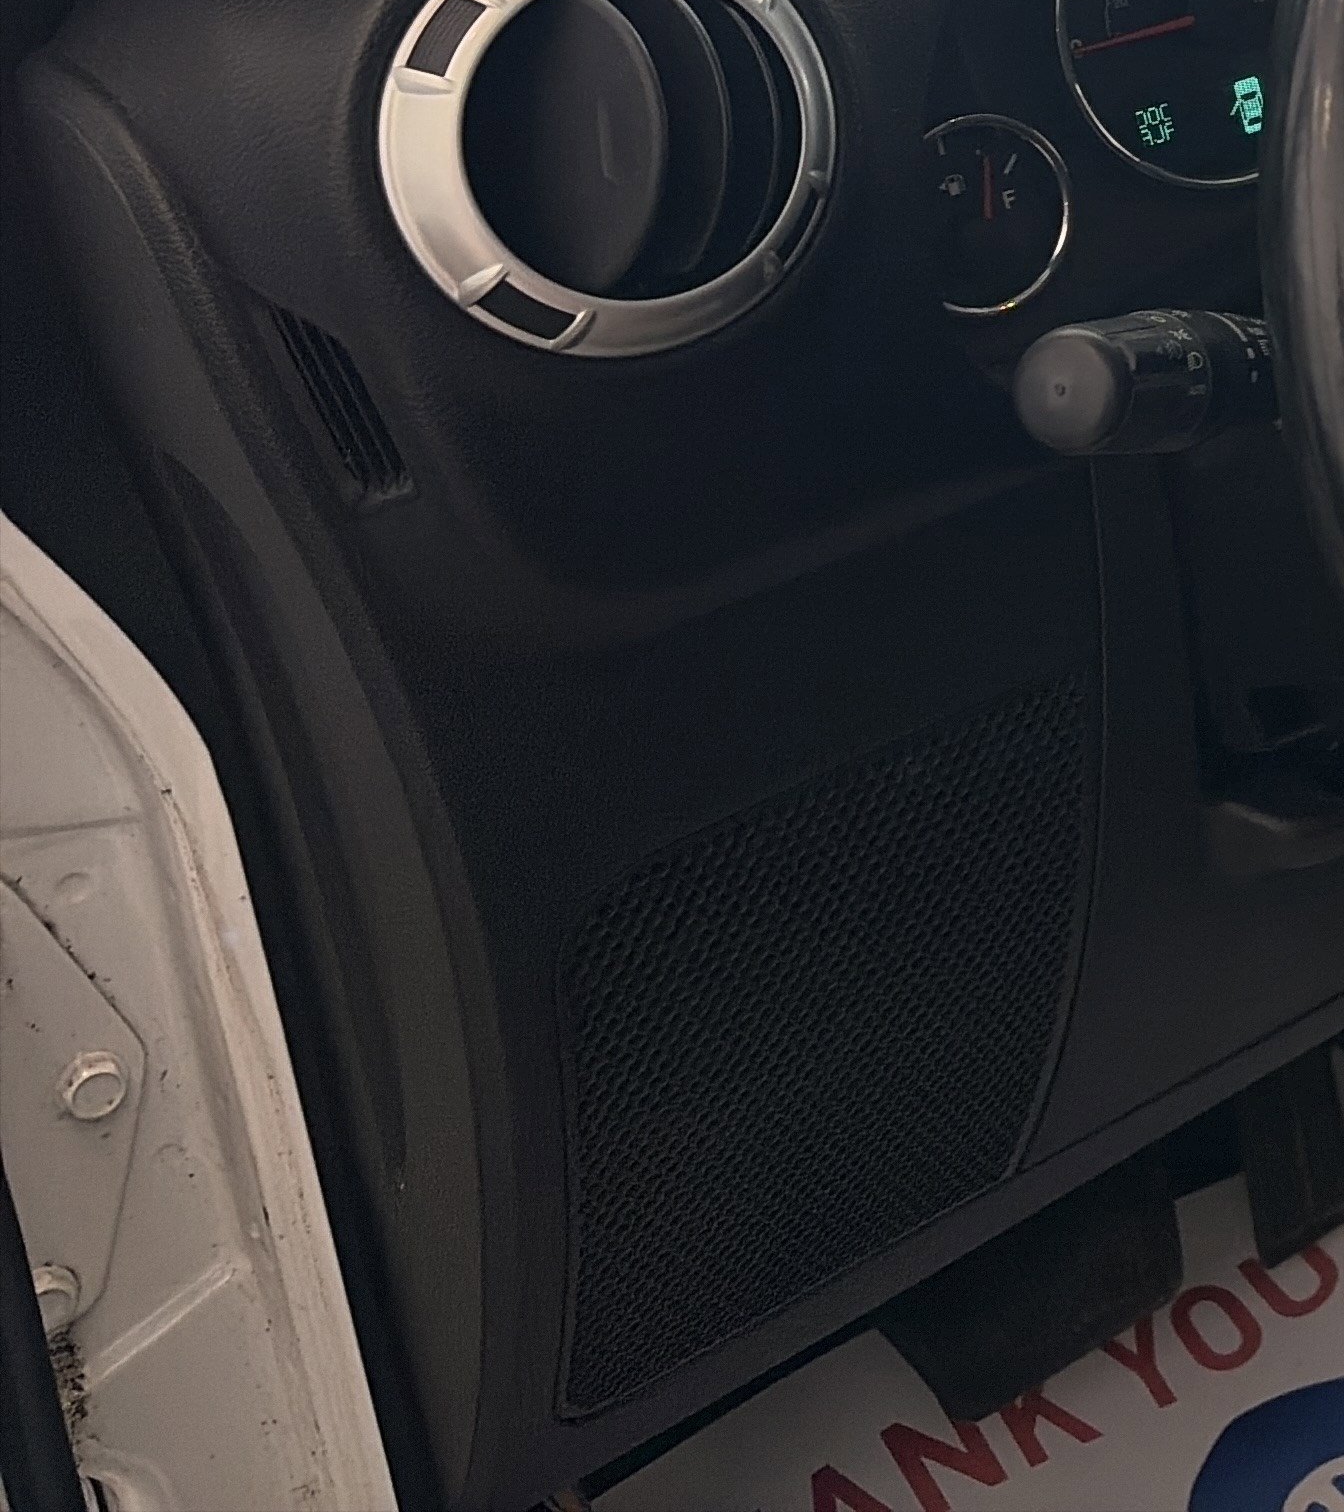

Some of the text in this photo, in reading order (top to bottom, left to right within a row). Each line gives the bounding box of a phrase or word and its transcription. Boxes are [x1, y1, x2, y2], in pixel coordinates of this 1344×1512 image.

[1001, 188, 1016, 210] F
[808, 1245, 1340, 1511] ANK YOU
